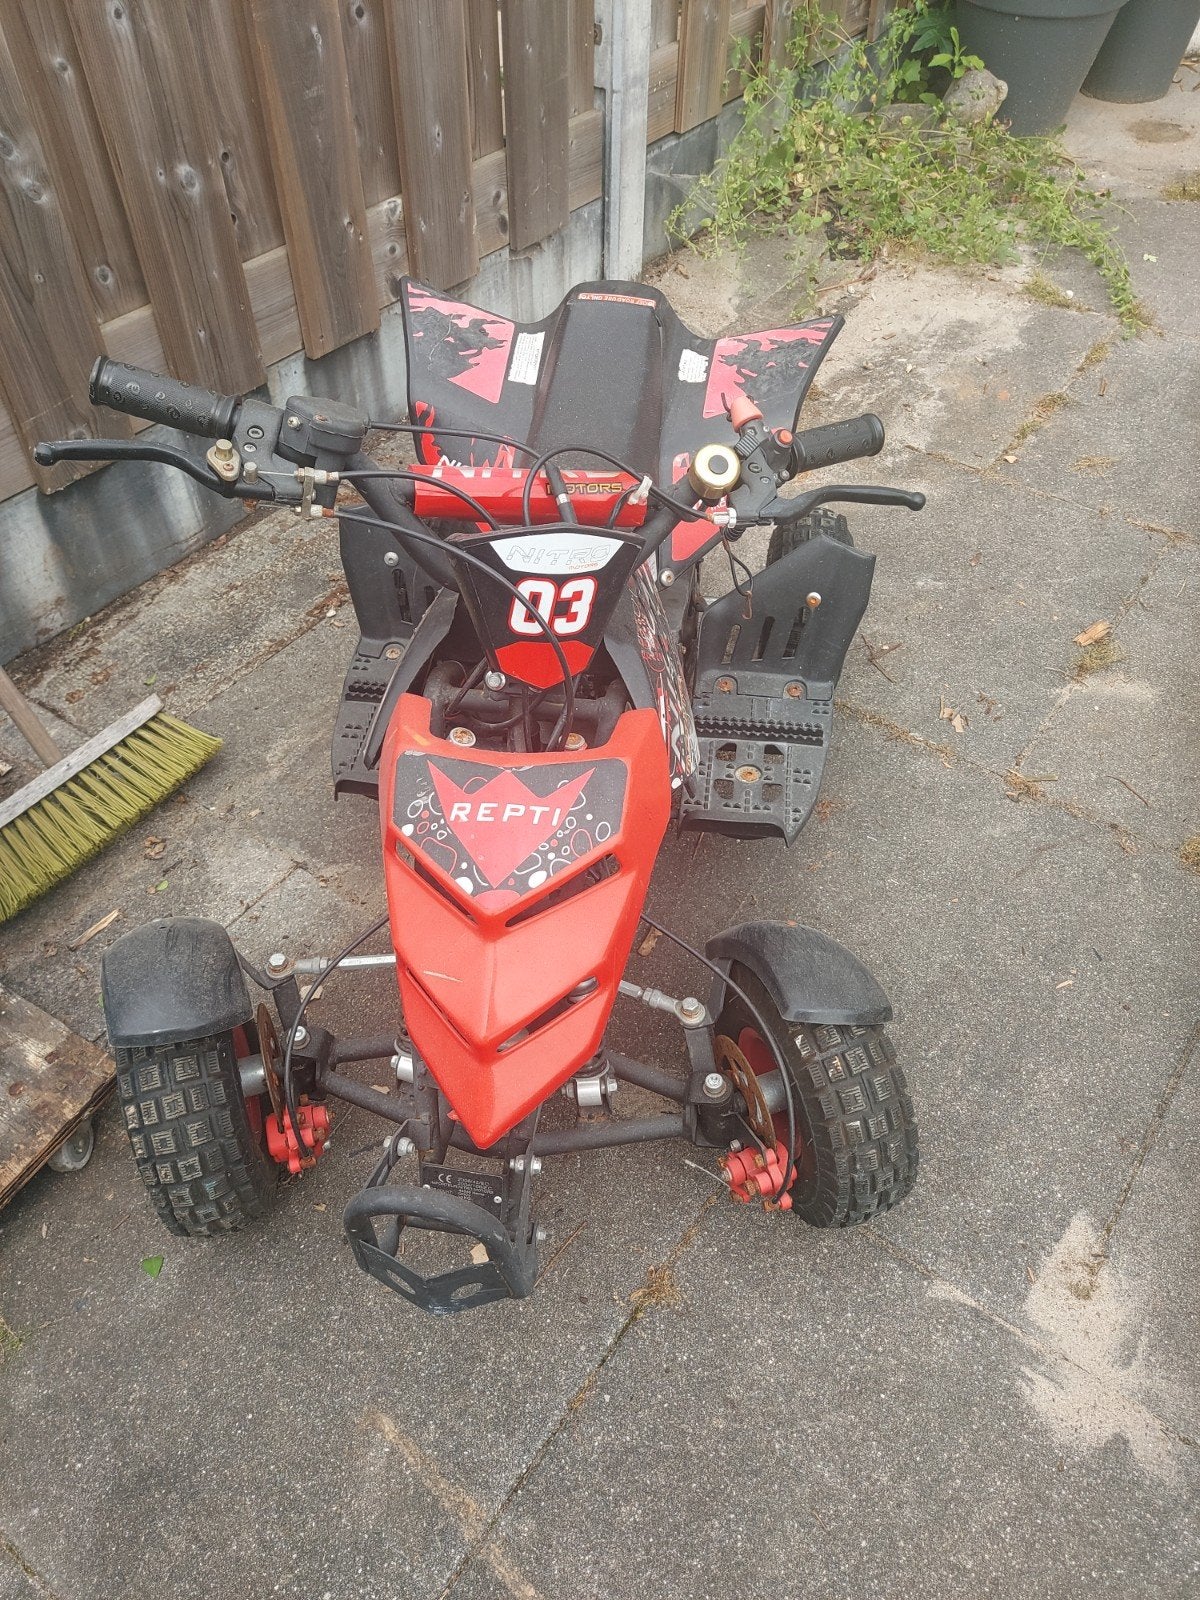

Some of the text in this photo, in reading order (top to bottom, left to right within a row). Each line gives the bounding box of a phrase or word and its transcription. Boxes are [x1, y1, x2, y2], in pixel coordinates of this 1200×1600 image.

[506, 544, 611, 567] NITRO
[508, 576, 598, 636] 03
[449, 803, 562, 827] REPTI
